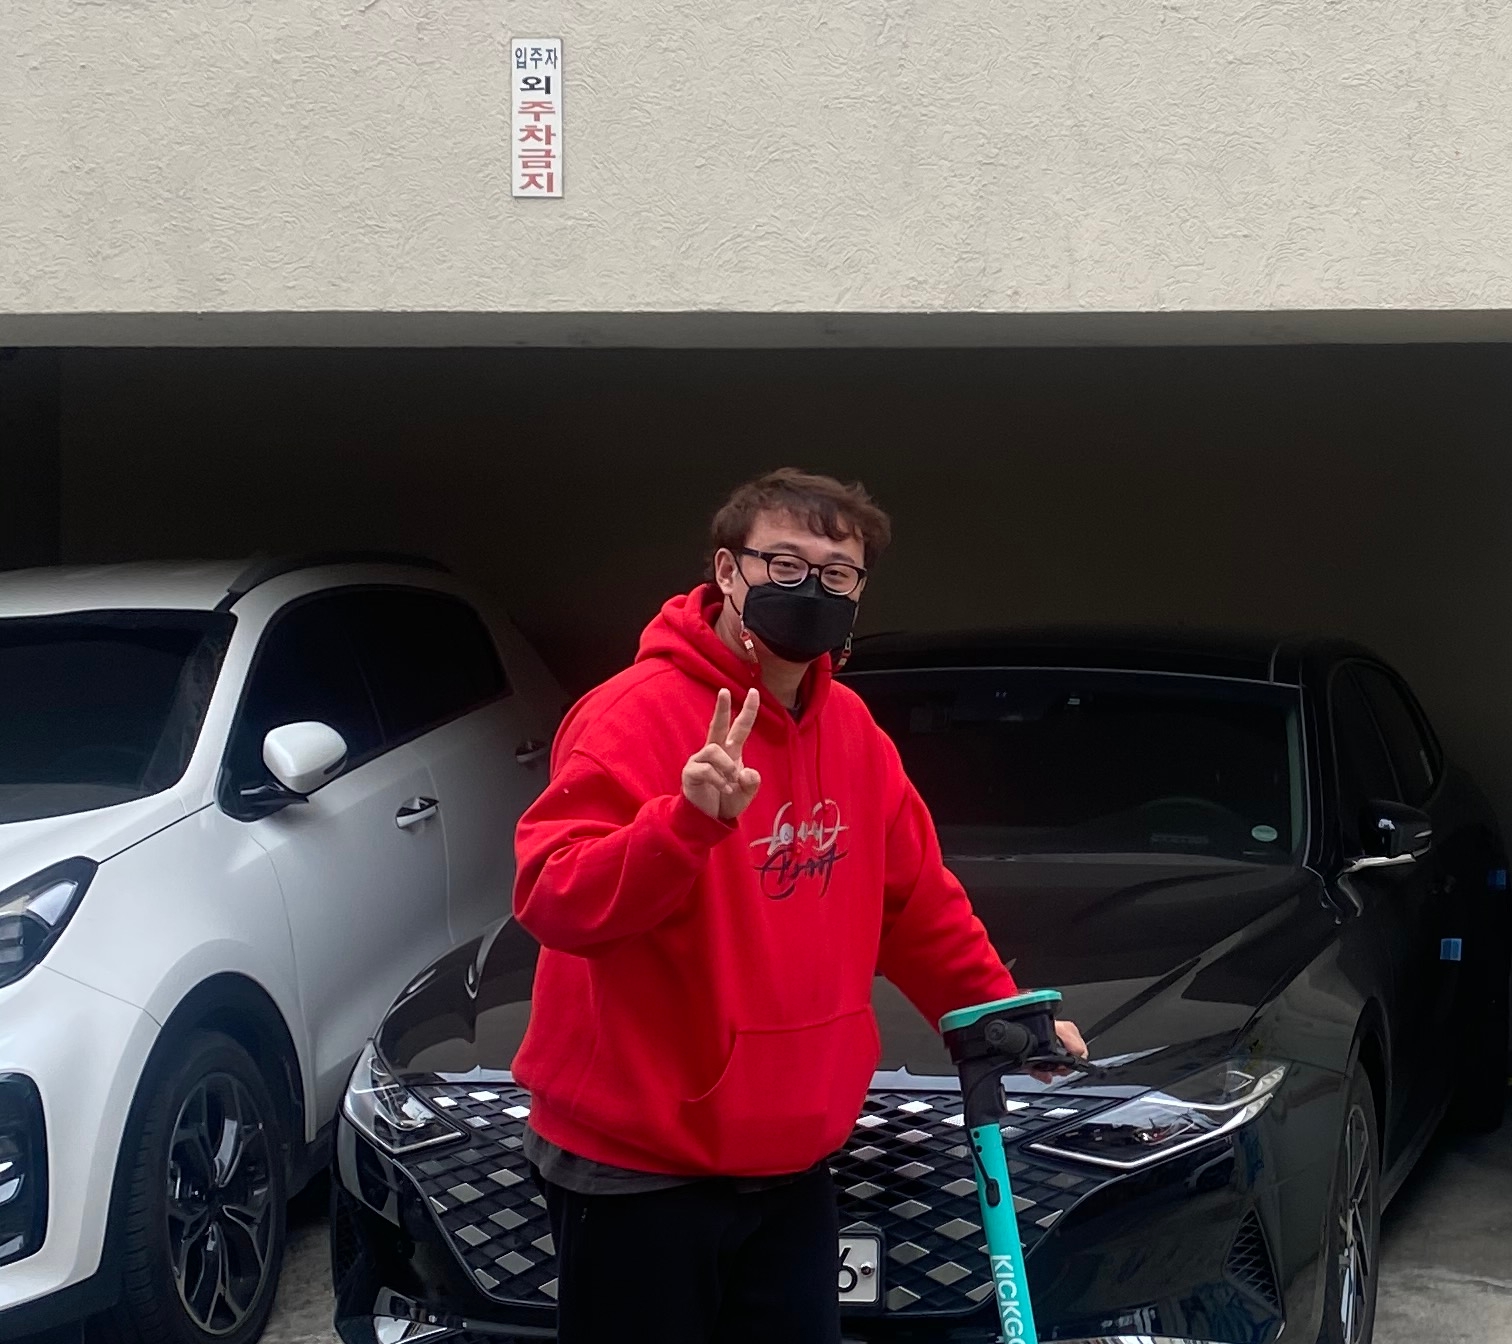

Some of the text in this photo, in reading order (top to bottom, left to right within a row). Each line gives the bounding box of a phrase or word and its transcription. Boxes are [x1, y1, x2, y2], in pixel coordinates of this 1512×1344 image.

[515, 46, 558, 70] 입주자
[519, 75, 552, 95] 외
[517, 100, 557, 193] 주차금지
